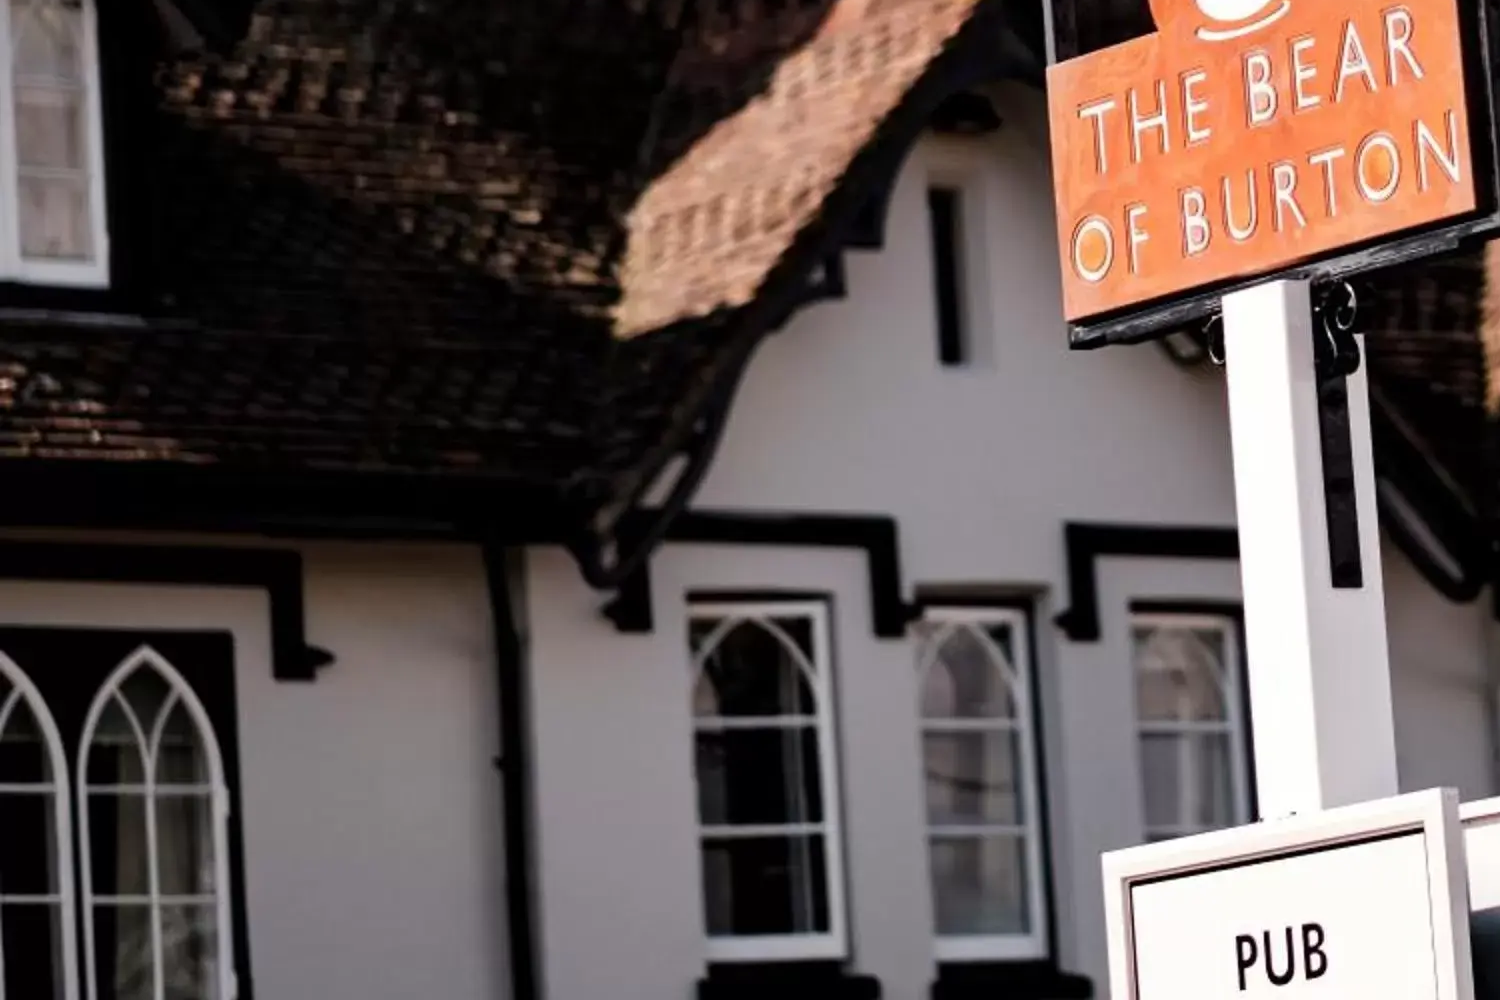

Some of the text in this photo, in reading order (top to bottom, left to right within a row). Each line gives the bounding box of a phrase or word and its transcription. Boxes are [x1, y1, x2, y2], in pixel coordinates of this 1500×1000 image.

[1078, 5, 1424, 175] THE BEAR
[1071, 108, 1461, 284] OF BURTON
[1235, 922, 1328, 992] PUB
